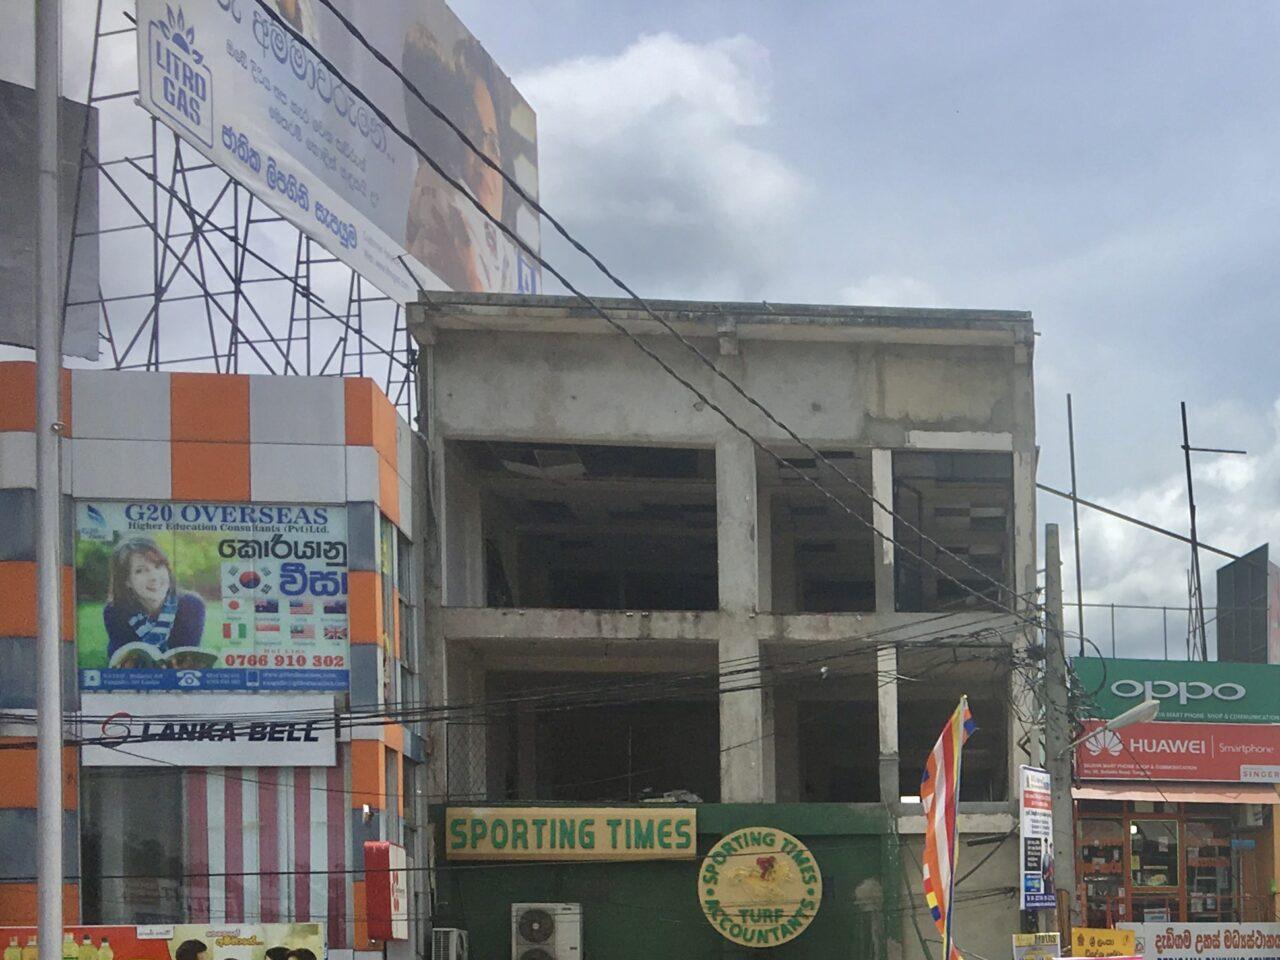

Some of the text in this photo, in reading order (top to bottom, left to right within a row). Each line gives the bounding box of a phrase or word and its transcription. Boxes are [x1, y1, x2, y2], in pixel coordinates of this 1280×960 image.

[156, 40, 207, 102] LITRO
[163, 76, 201, 126] GAS
[124, 503, 329, 526] G20 OVERSEAS
[128, 521, 163, 531] Higher
[165, 522, 218, 532] Education
[220, 523, 280, 533] Consultants
[274, 654, 308, 668] 910
[312, 655, 345, 668] 302
[140, 722, 319, 742] LANKA BELL
[1129, 738, 1274, 755] HUAWEI Smartphone
[1243, 770, 1280, 779] SINGER
[450, 818, 693, 850] SPORTING TIMES
[703, 830, 818, 886] SPORTING TIMES
[704, 898, 816, 944] ACCOUNTANTS
[738, 908, 784, 924] TURF
